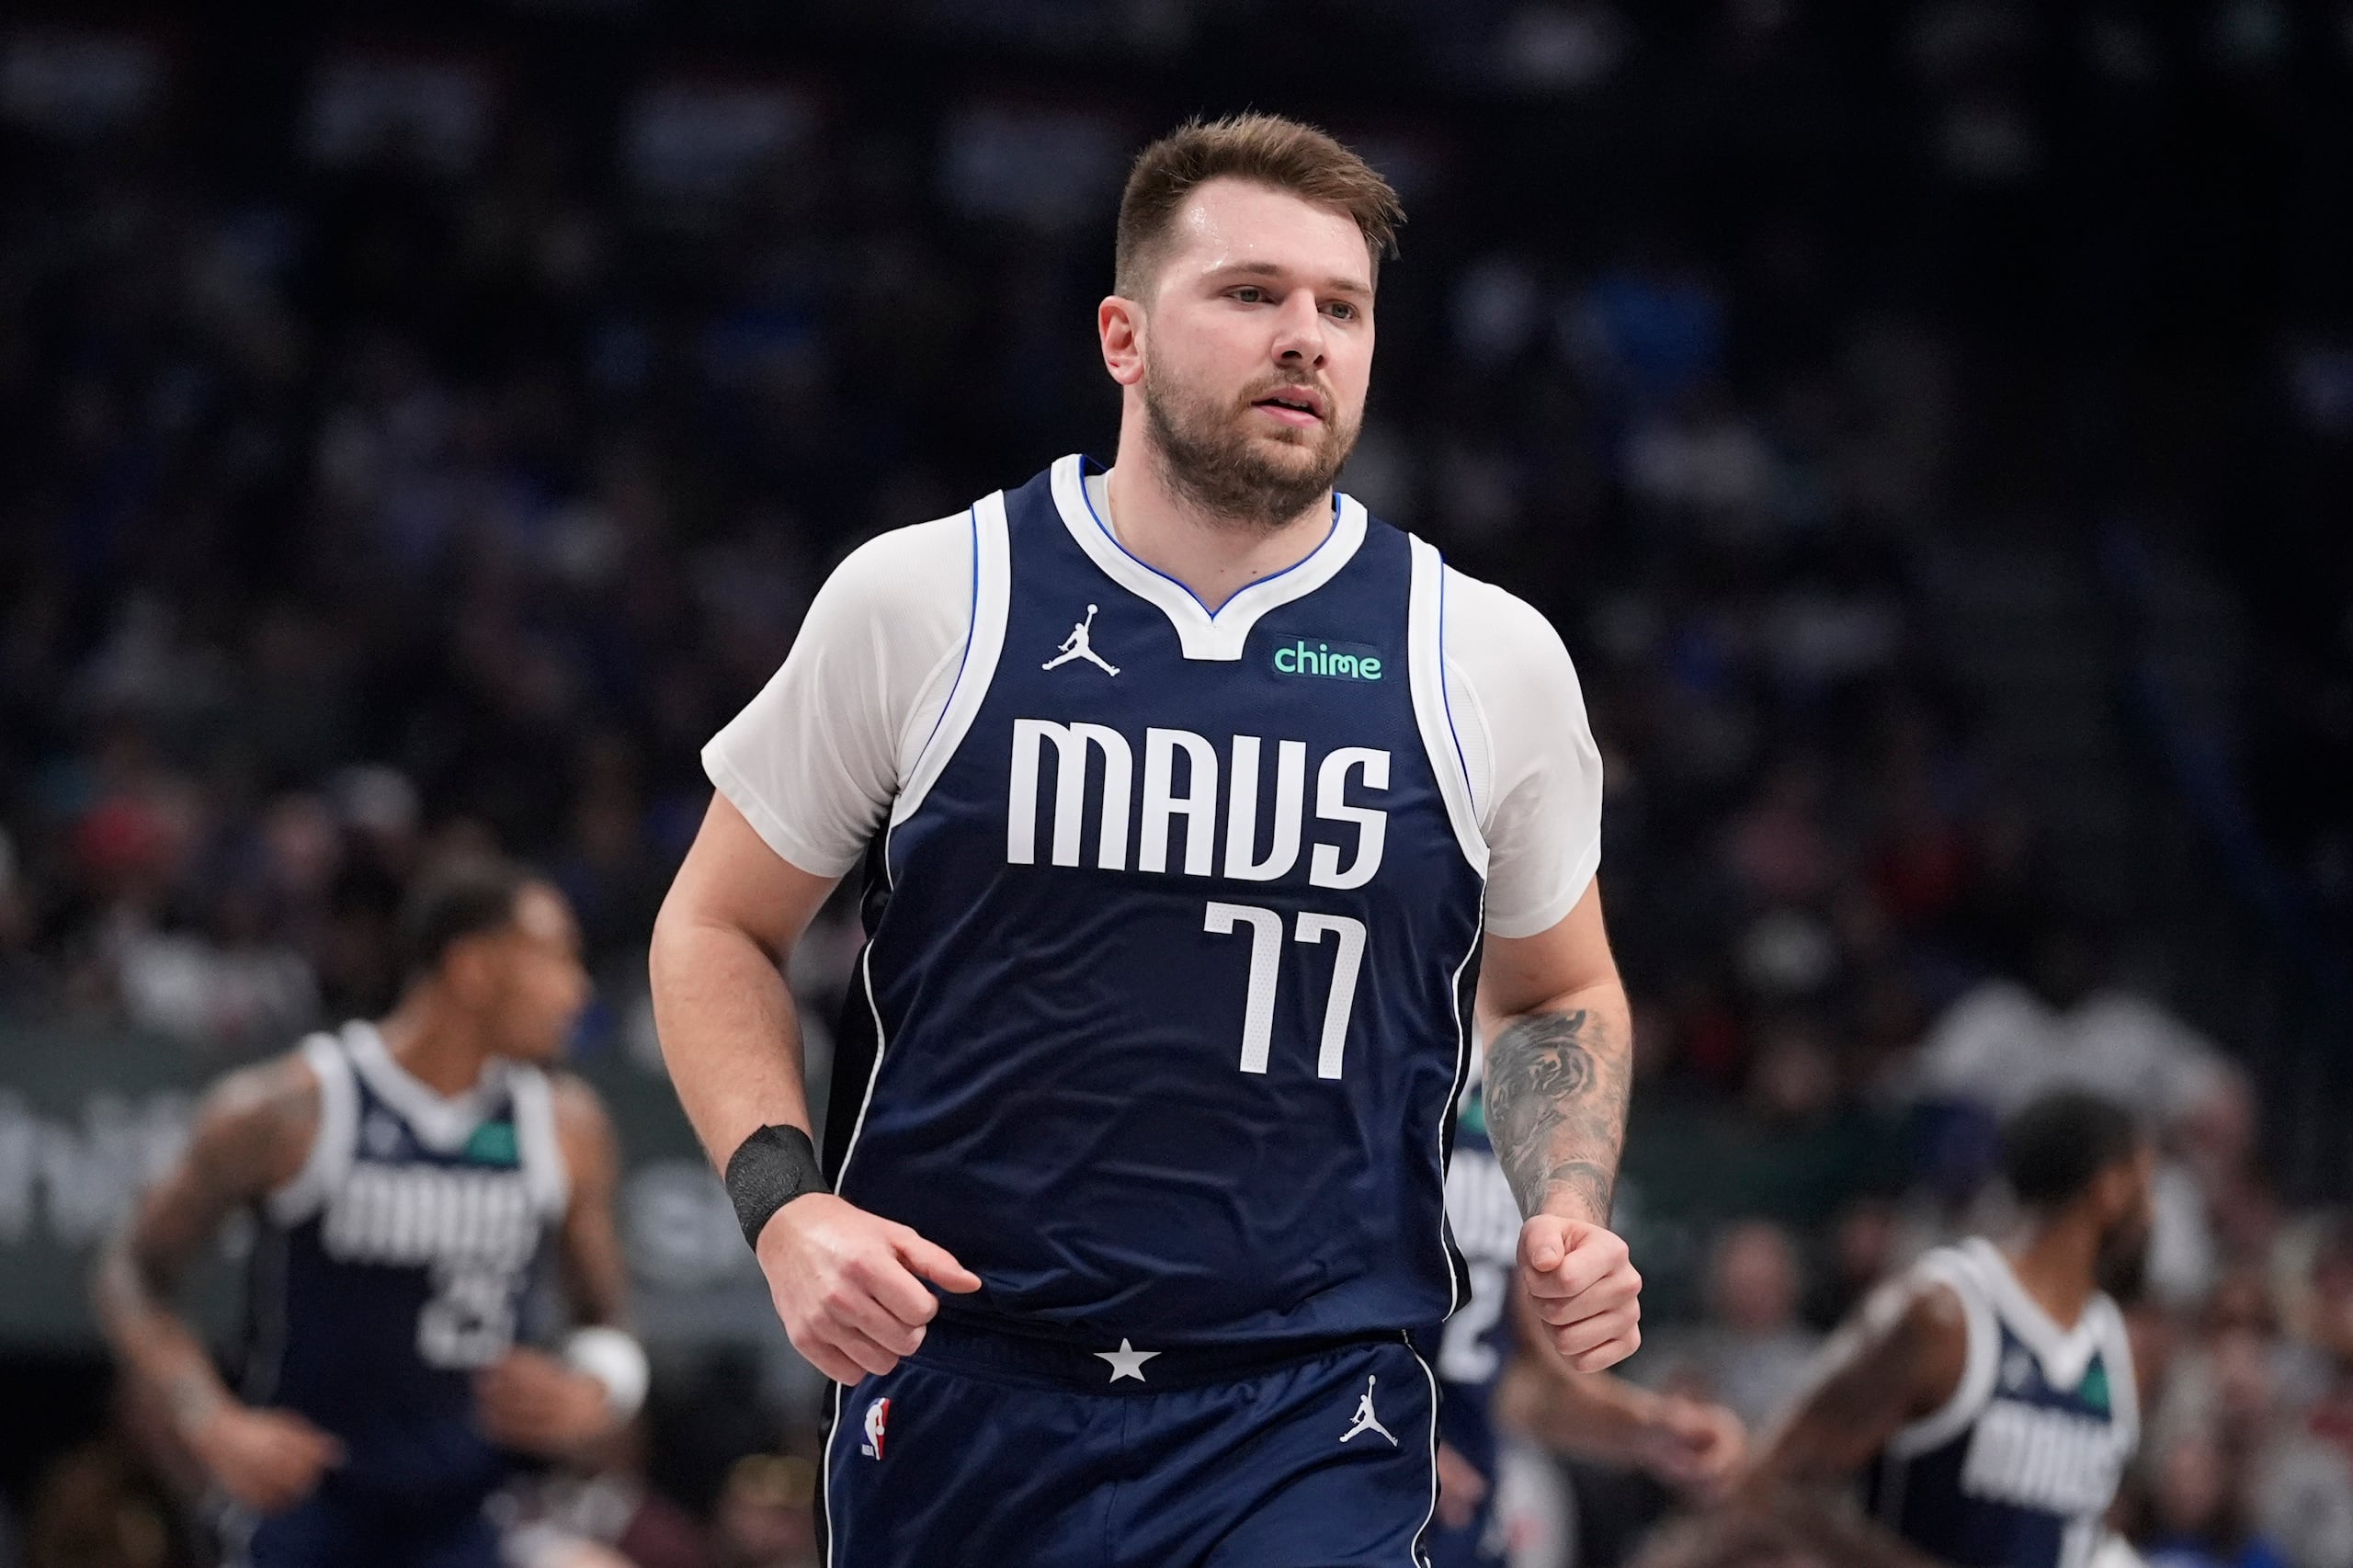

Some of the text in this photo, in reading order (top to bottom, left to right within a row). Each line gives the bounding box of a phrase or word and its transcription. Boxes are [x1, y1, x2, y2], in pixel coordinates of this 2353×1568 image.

[1274, 641, 1381, 680] chime
[1007, 718, 1391, 890] MAVS
[1203, 901, 1367, 1080] 77
